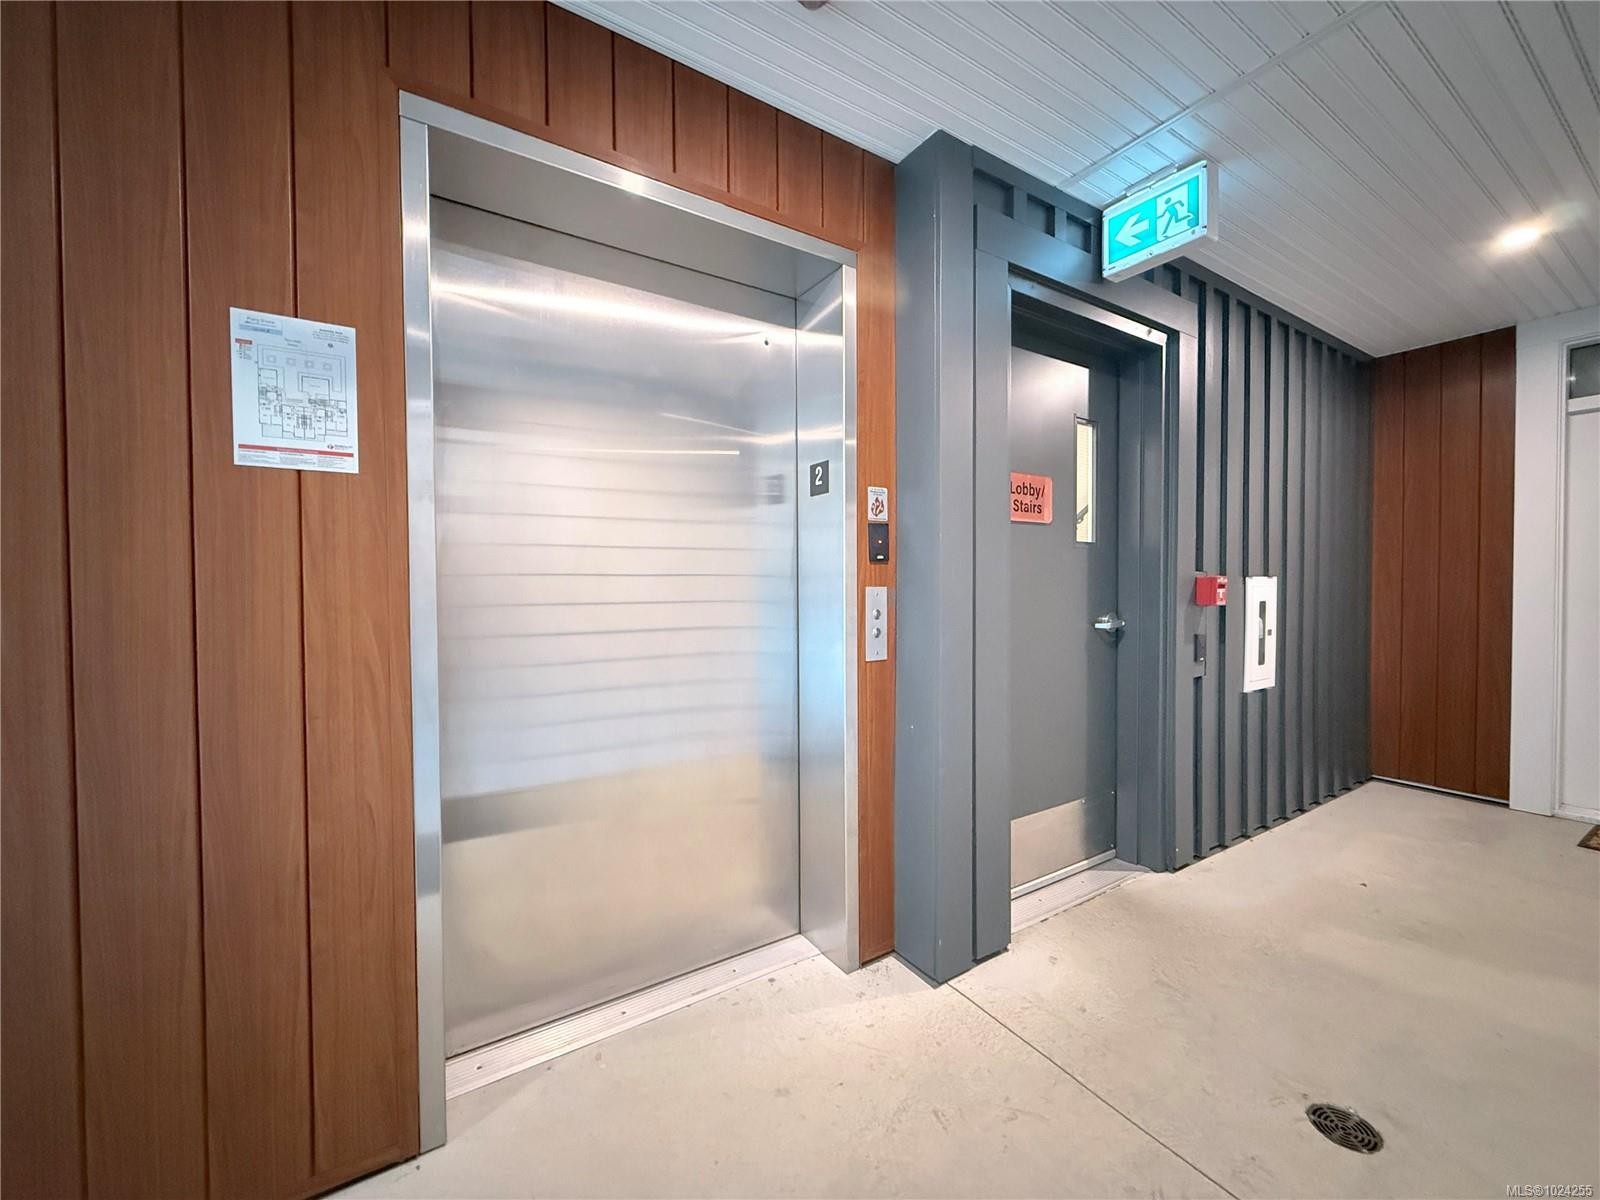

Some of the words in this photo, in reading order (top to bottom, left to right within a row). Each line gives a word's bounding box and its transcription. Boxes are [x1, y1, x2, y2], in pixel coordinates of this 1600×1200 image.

[815, 466, 823, 485] 2
[1010, 481, 1045, 501] Lobby/
[1013, 498, 1042, 514] Stairs
